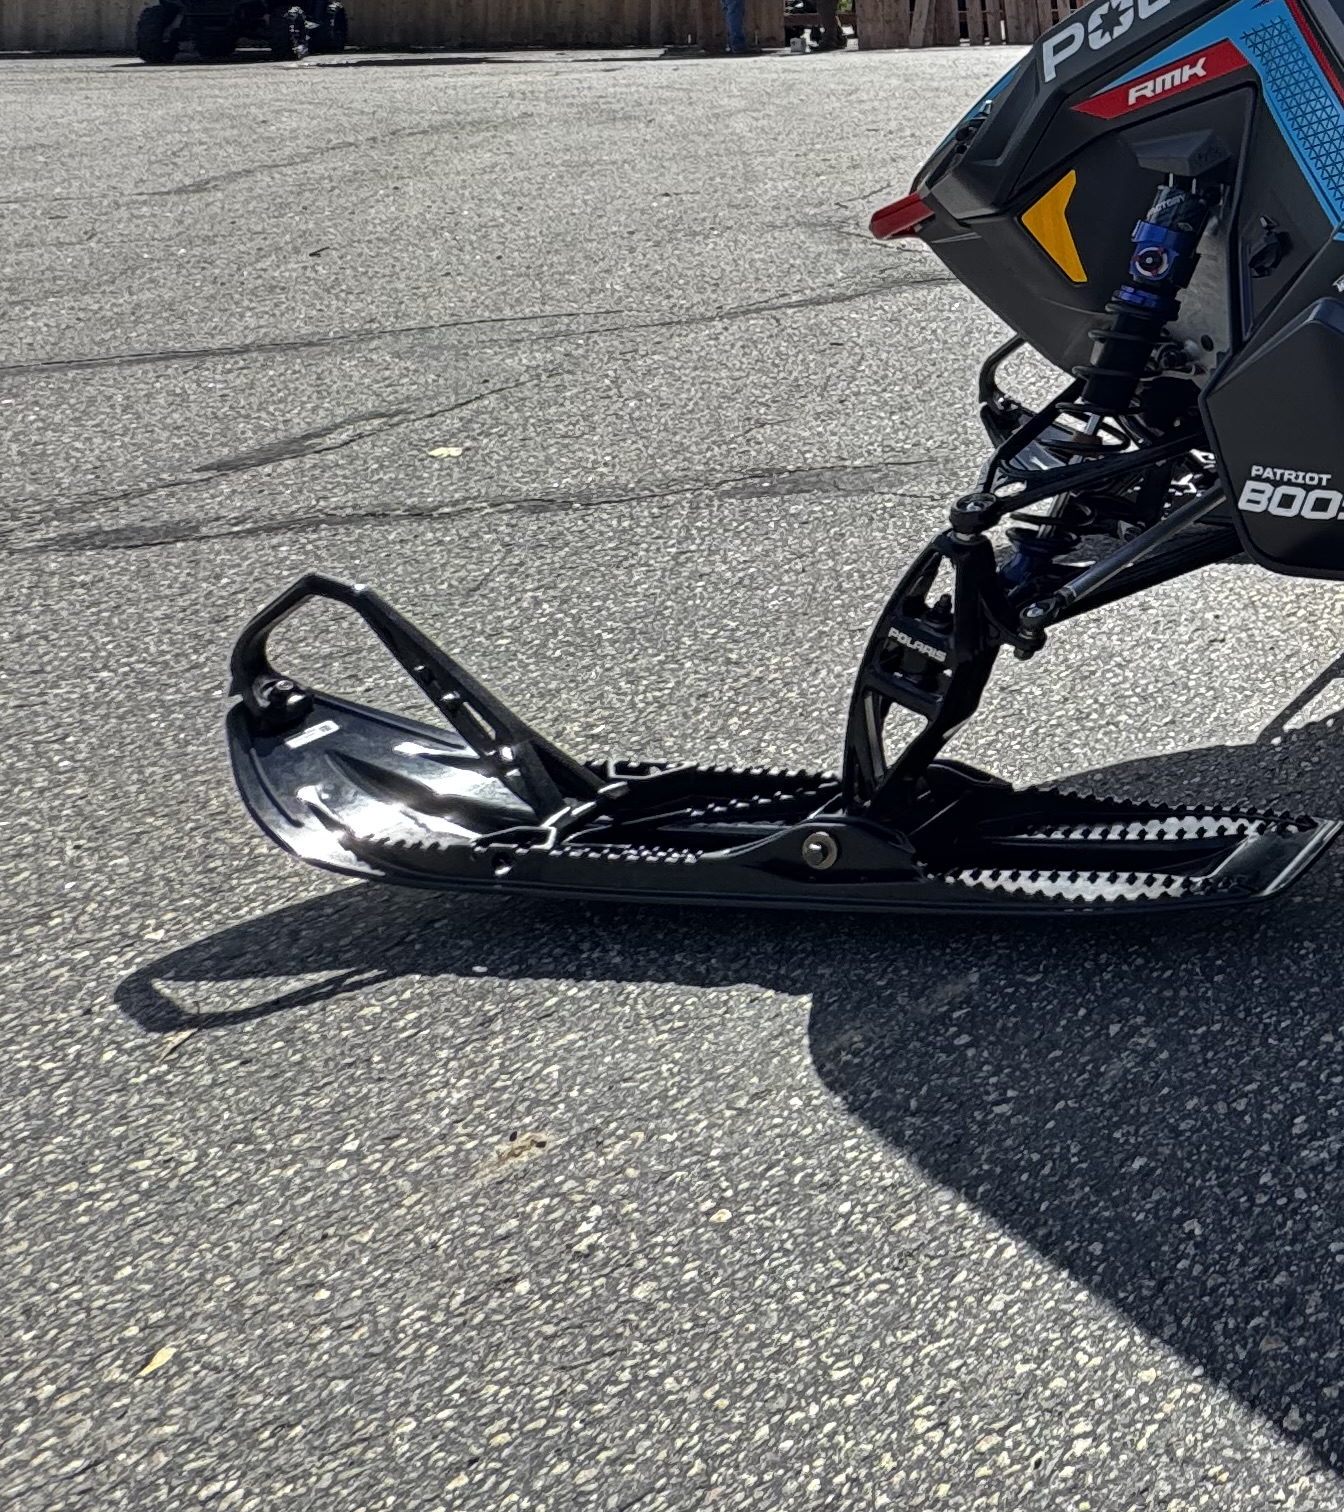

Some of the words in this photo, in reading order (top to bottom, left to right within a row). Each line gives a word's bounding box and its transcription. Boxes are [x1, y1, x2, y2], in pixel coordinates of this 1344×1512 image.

[1127, 56, 1207, 106] RMK
[1251, 465, 1332, 486] PATRIOT
[888, 627, 947, 662] POLARIS
